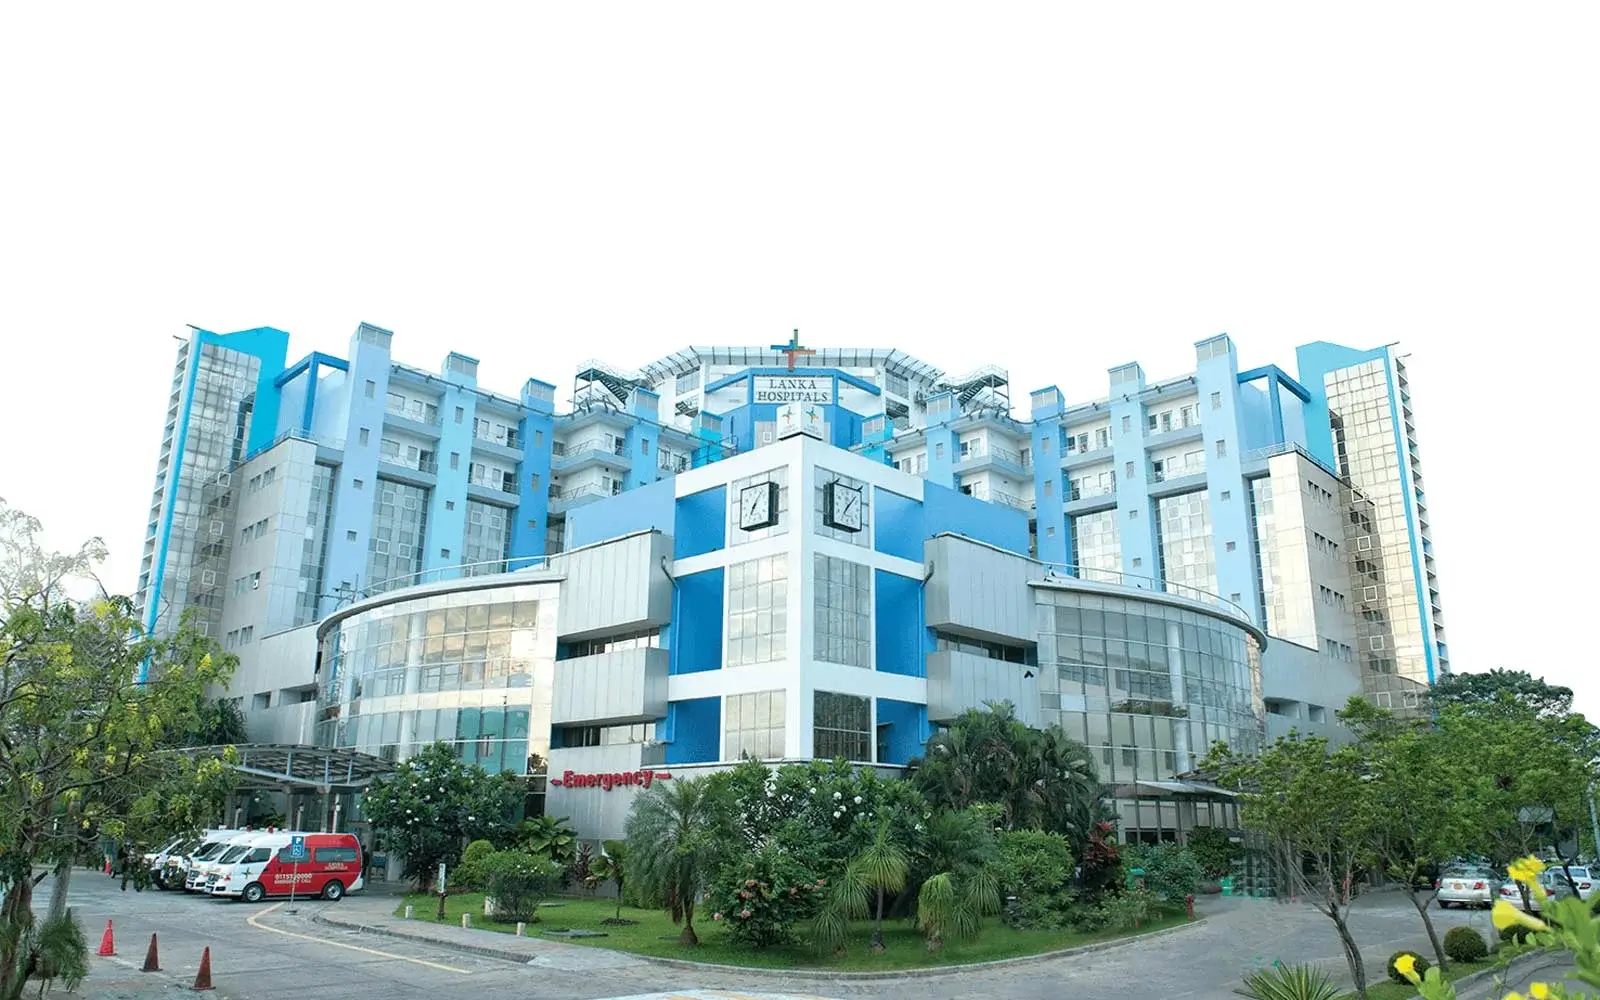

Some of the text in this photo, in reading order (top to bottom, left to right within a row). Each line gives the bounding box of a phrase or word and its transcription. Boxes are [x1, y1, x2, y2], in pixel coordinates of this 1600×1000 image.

[769, 379, 817, 389] LANKA
[758, 391, 828, 402] HOSPITALS
[563, 770, 653, 791] Emergency
